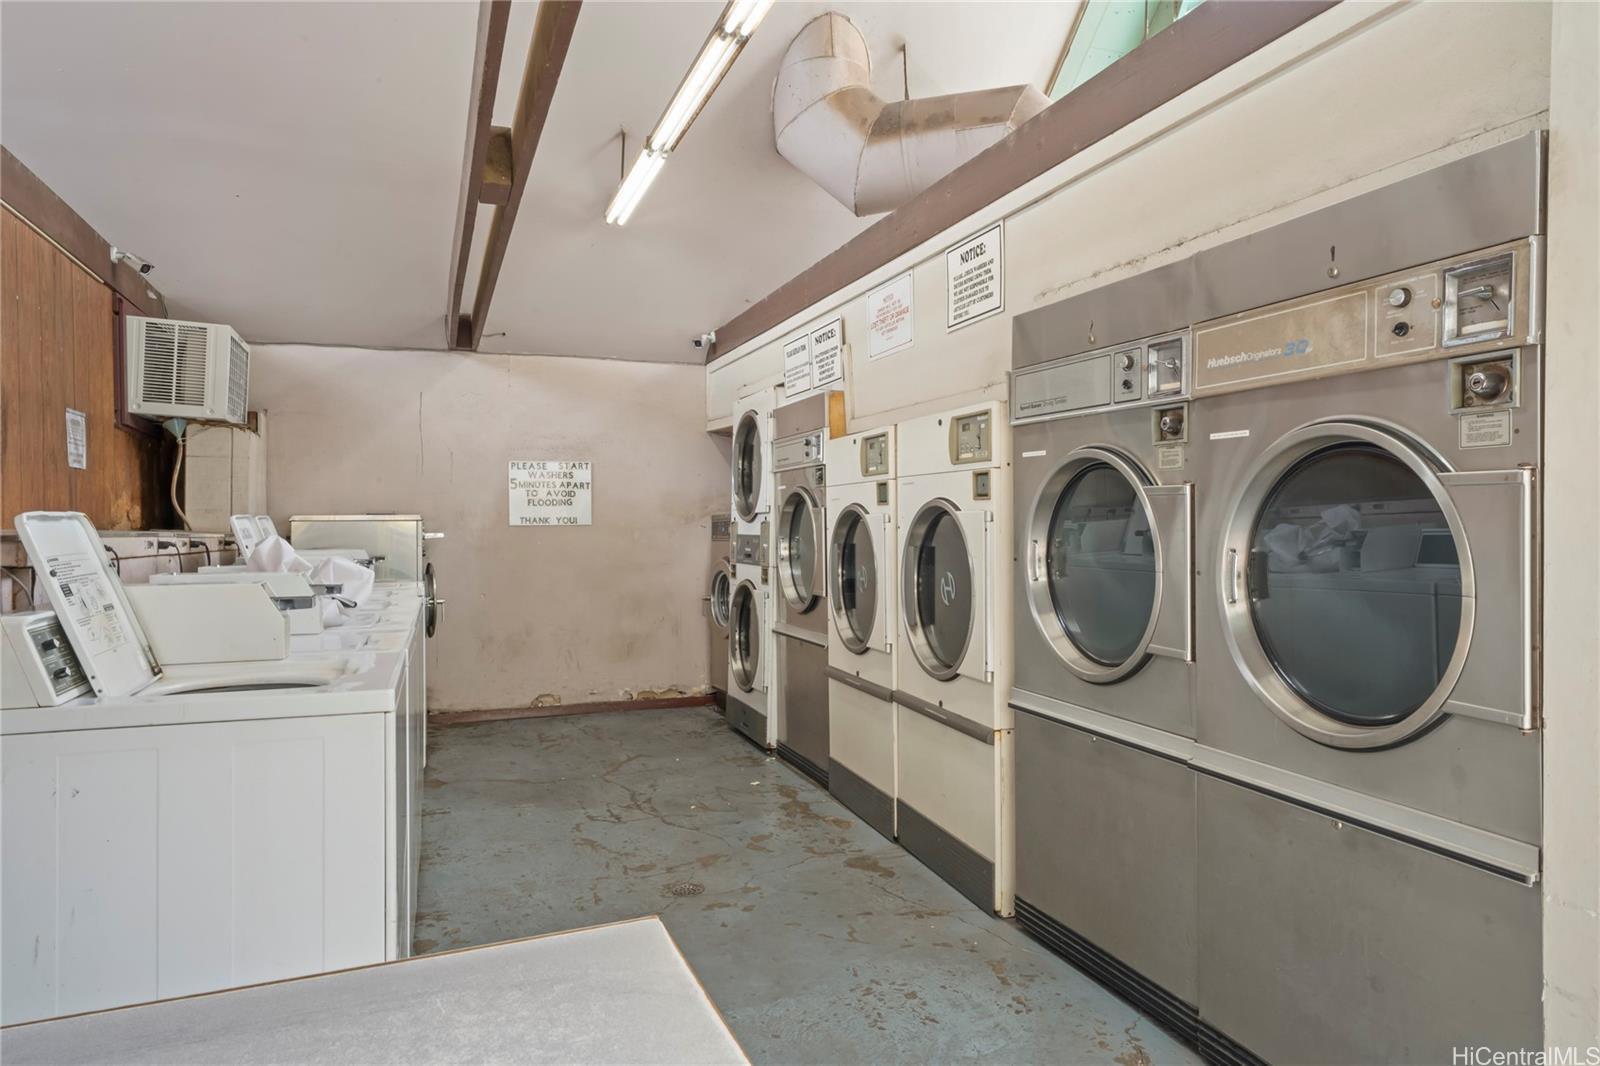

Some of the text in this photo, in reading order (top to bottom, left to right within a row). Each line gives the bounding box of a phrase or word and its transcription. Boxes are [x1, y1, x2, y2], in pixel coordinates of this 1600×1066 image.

[960, 242, 986, 265] NOTICE:
[814, 328, 837, 346] NOTICE:
[510, 462, 590, 470] PLEASE START
[528, 471, 574, 479] WASHERS
[518, 481, 557, 489] MINUTES
[559, 481, 591, 490] APART
[526, 489, 577, 498] TO AVOID
[527, 498, 573, 507] FLOODING
[520, 516, 551, 524] THANK
